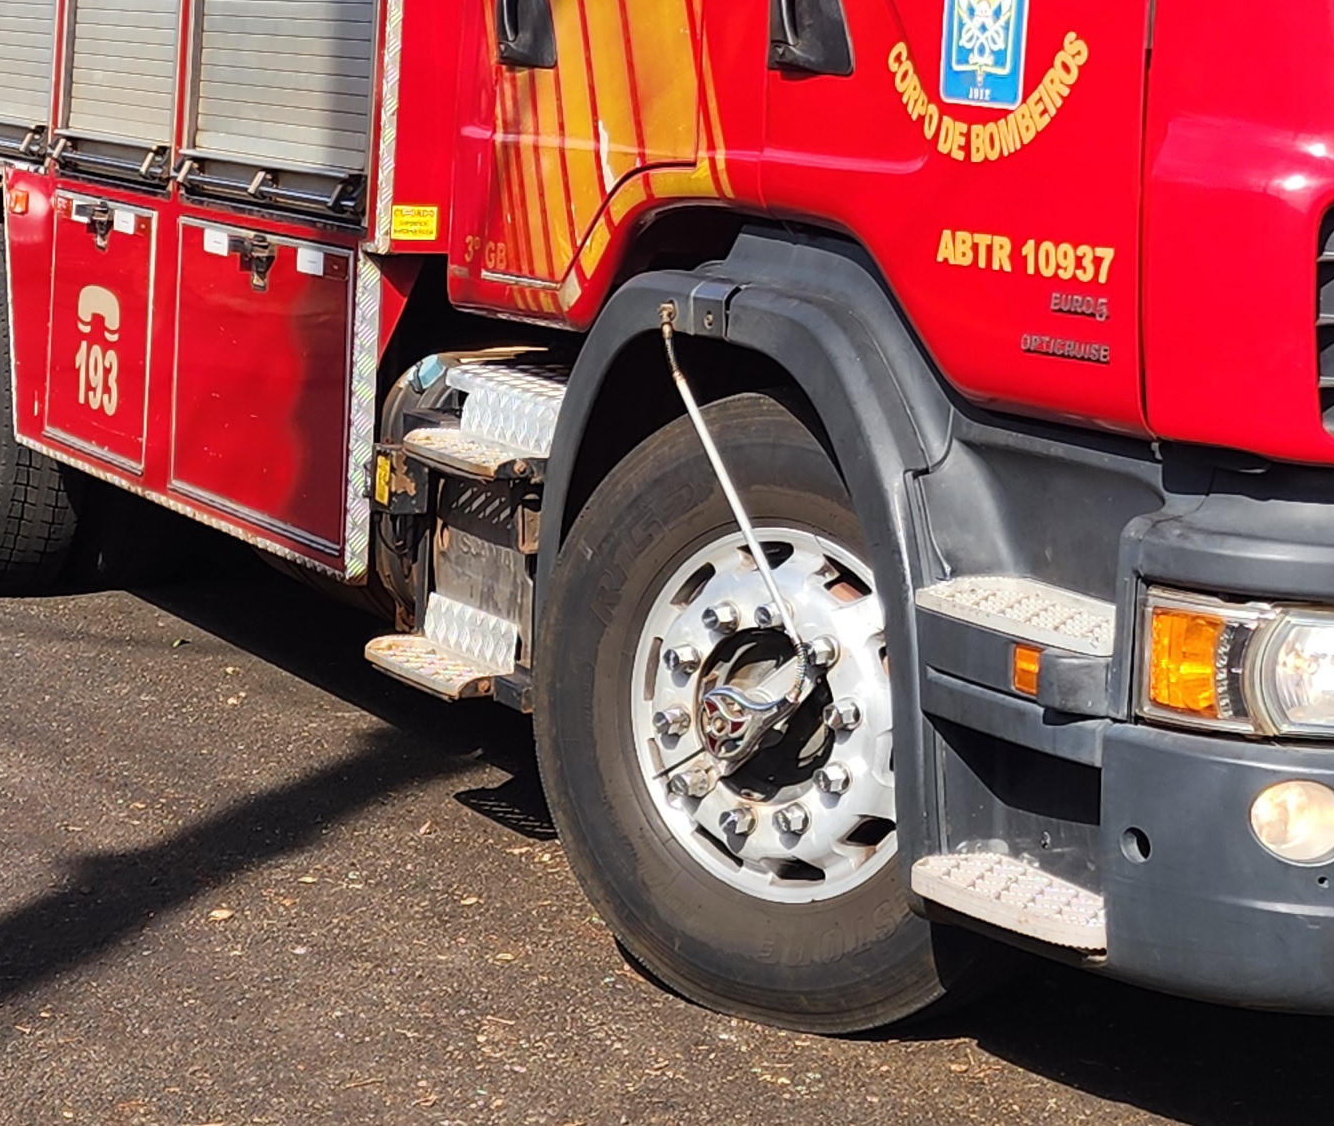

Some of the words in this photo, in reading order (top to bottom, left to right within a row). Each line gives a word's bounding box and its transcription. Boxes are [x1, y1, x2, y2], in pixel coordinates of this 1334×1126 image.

[888, 42, 939, 140] CORPO
[937, 115, 968, 161] DE
[970, 31, 1089, 163] BOMBEIROS
[485, 241, 508, 269] GB
[936, 229, 1012, 272] ABTR
[1021, 239, 1114, 284] 10937
[1021, 334, 1110, 362] OPTICRUISE
[75, 340, 118, 416] 193
